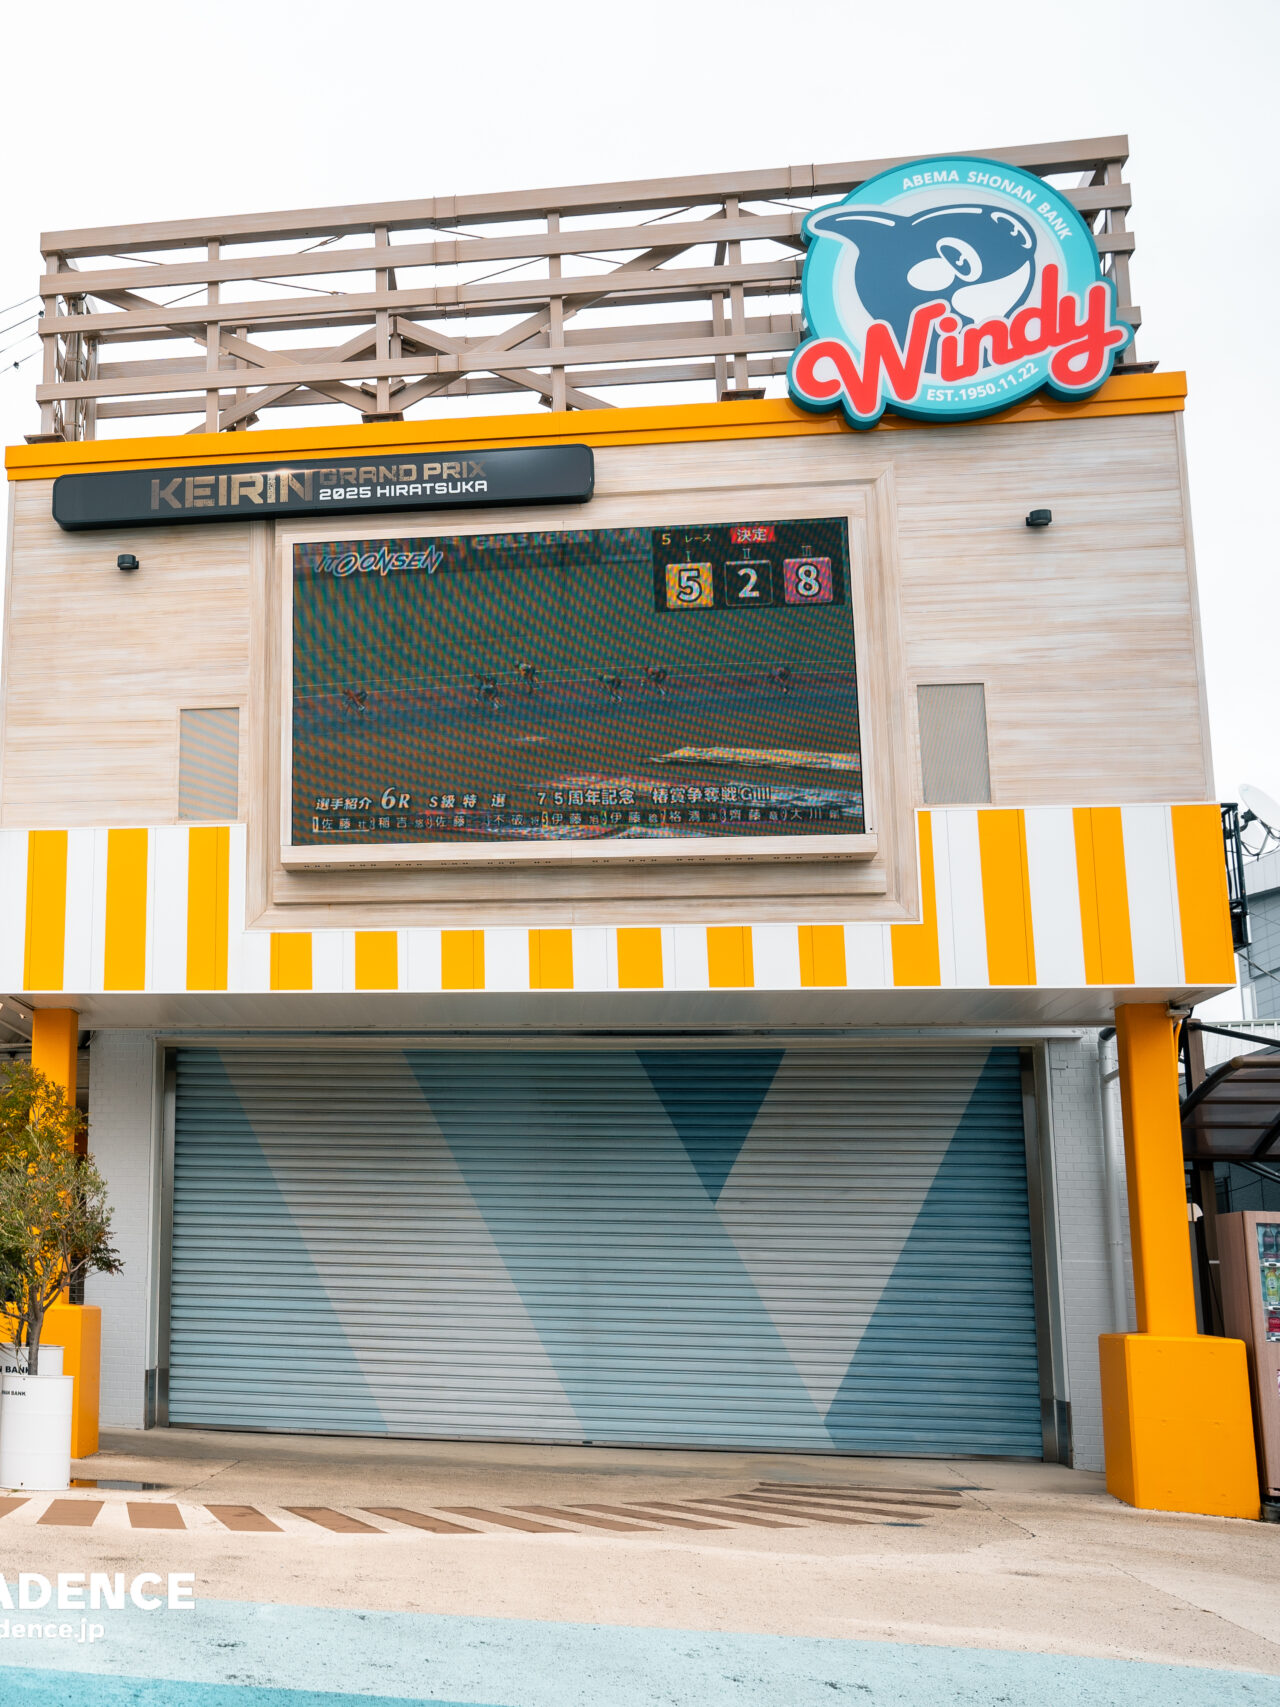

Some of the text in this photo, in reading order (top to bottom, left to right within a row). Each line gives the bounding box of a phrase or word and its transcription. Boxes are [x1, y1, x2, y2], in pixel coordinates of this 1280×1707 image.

[902, 170, 1073, 241] ABEMA SHONAN BANK
[796, 264, 1123, 415] Windy
[926, 362, 1038, 402] EST.1950.11.22
[151, 461, 487, 511] KEIRIN GRAND PRIX
[320, 480, 487, 500] 2025 HIRATSUKA
[661, 533, 671, 546] 5
[736, 528, 767, 542] 決定
[677, 563, 820, 602] 5 2 8
[315, 797, 372, 811] 選手紹介
[381, 787, 410, 809] 6R
